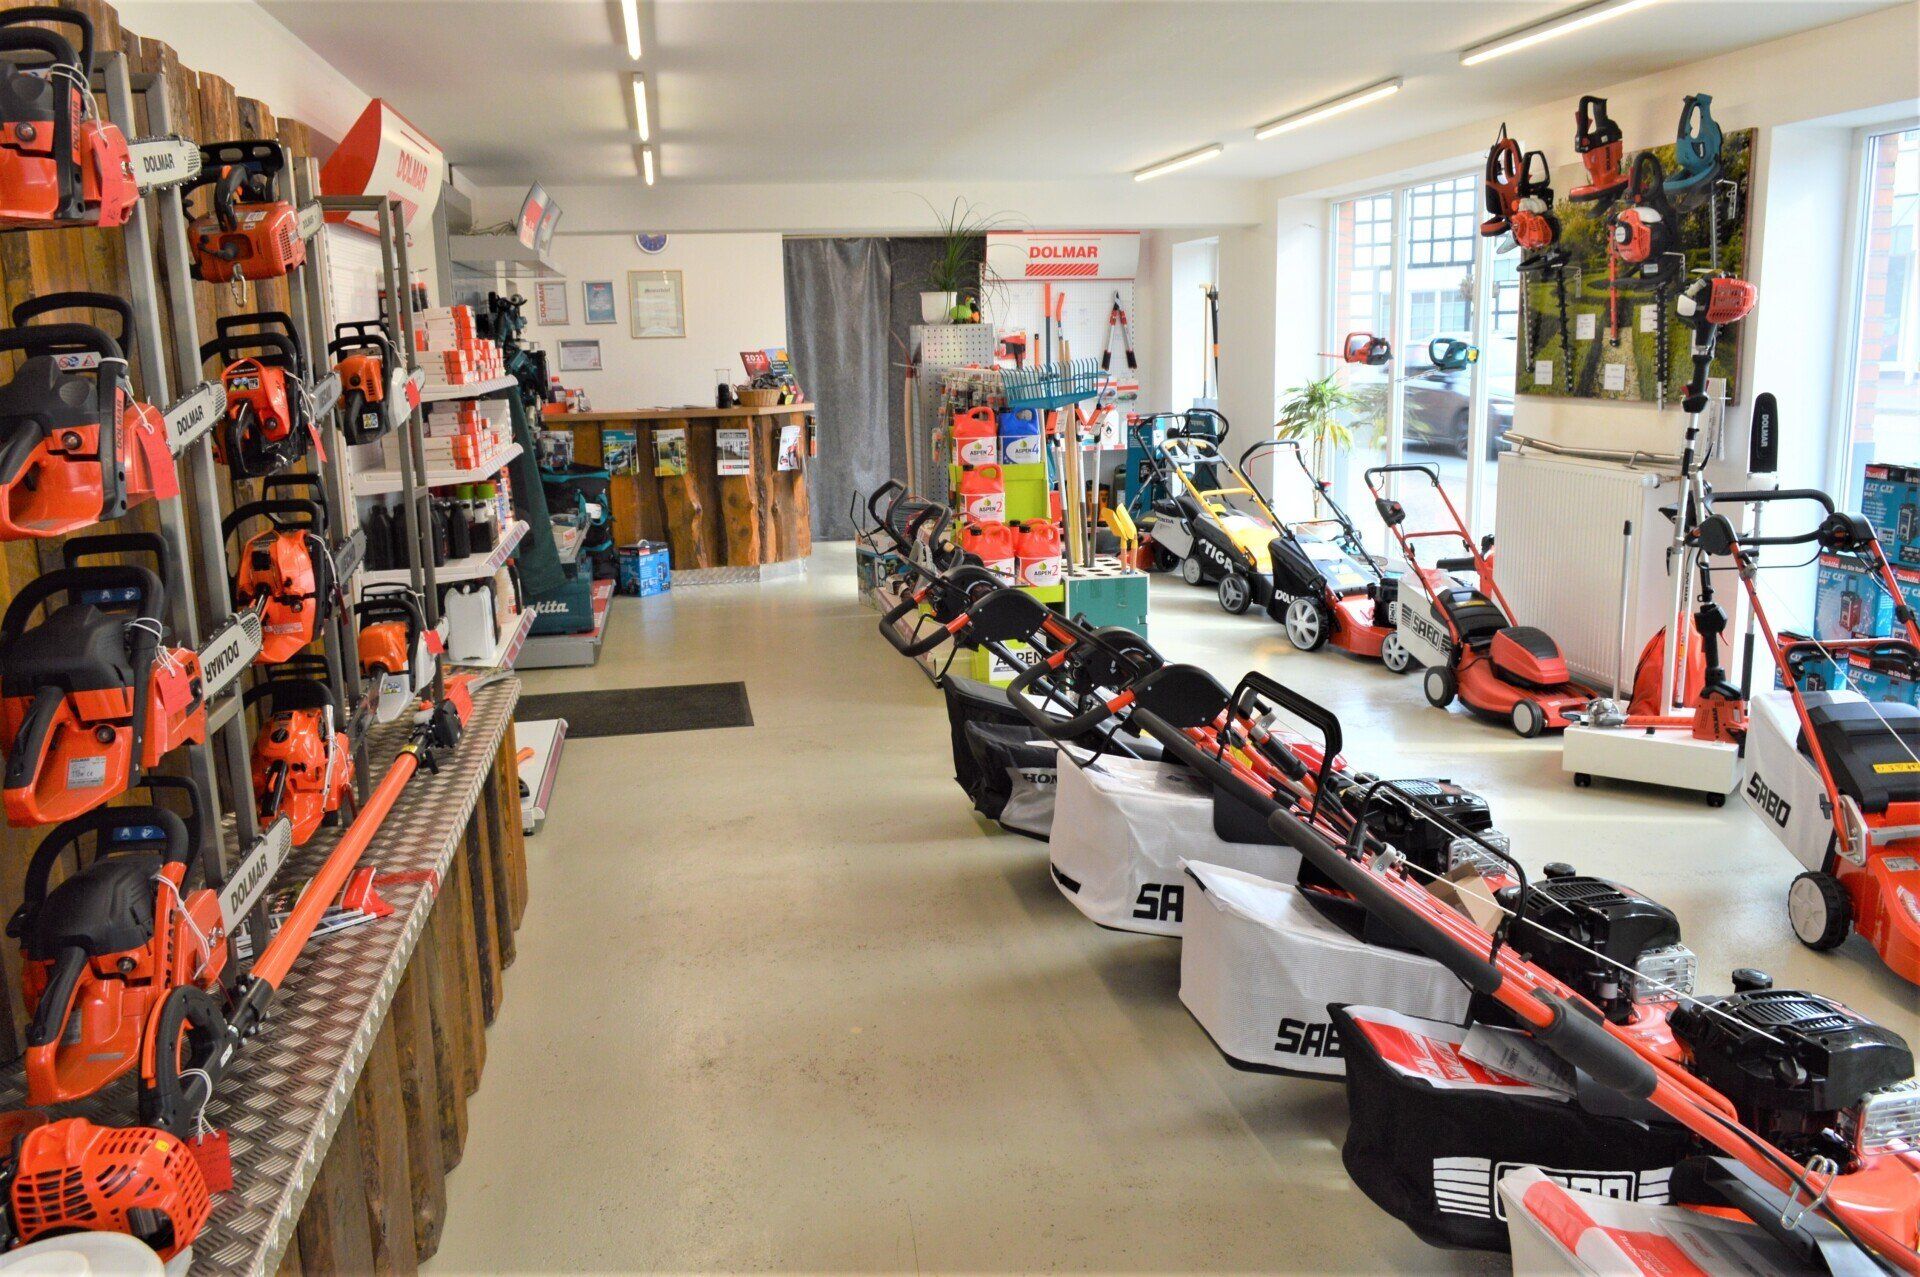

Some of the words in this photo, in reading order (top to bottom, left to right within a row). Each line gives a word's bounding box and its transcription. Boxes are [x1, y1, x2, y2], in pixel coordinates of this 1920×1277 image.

[142, 153, 176, 174] DOLMAR
[396, 150, 429, 193] DOLMAR
[1028, 245, 1099, 259] DOLMAR
[176, 405, 205, 436] DOLMAR
[1761, 413, 1770, 448] DOLMAR
[987, 444, 994, 456] 2
[1031, 443, 1039, 455] 4
[995, 501, 1003, 513] 2
[1051, 564, 1059, 576] 2
[526, 601, 570, 614] akita
[1412, 616, 1440, 648] SABO
[204, 640, 240, 684] DOLMAR
[1848, 657, 1871, 670] Makita
[1021, 773, 1058, 784] HON
[1746, 771, 1792, 828] SABO
[230, 854, 269, 915] DOLMAR
[1132, 882, 1184, 923] SA
[1274, 1017, 1345, 1058] SAB
